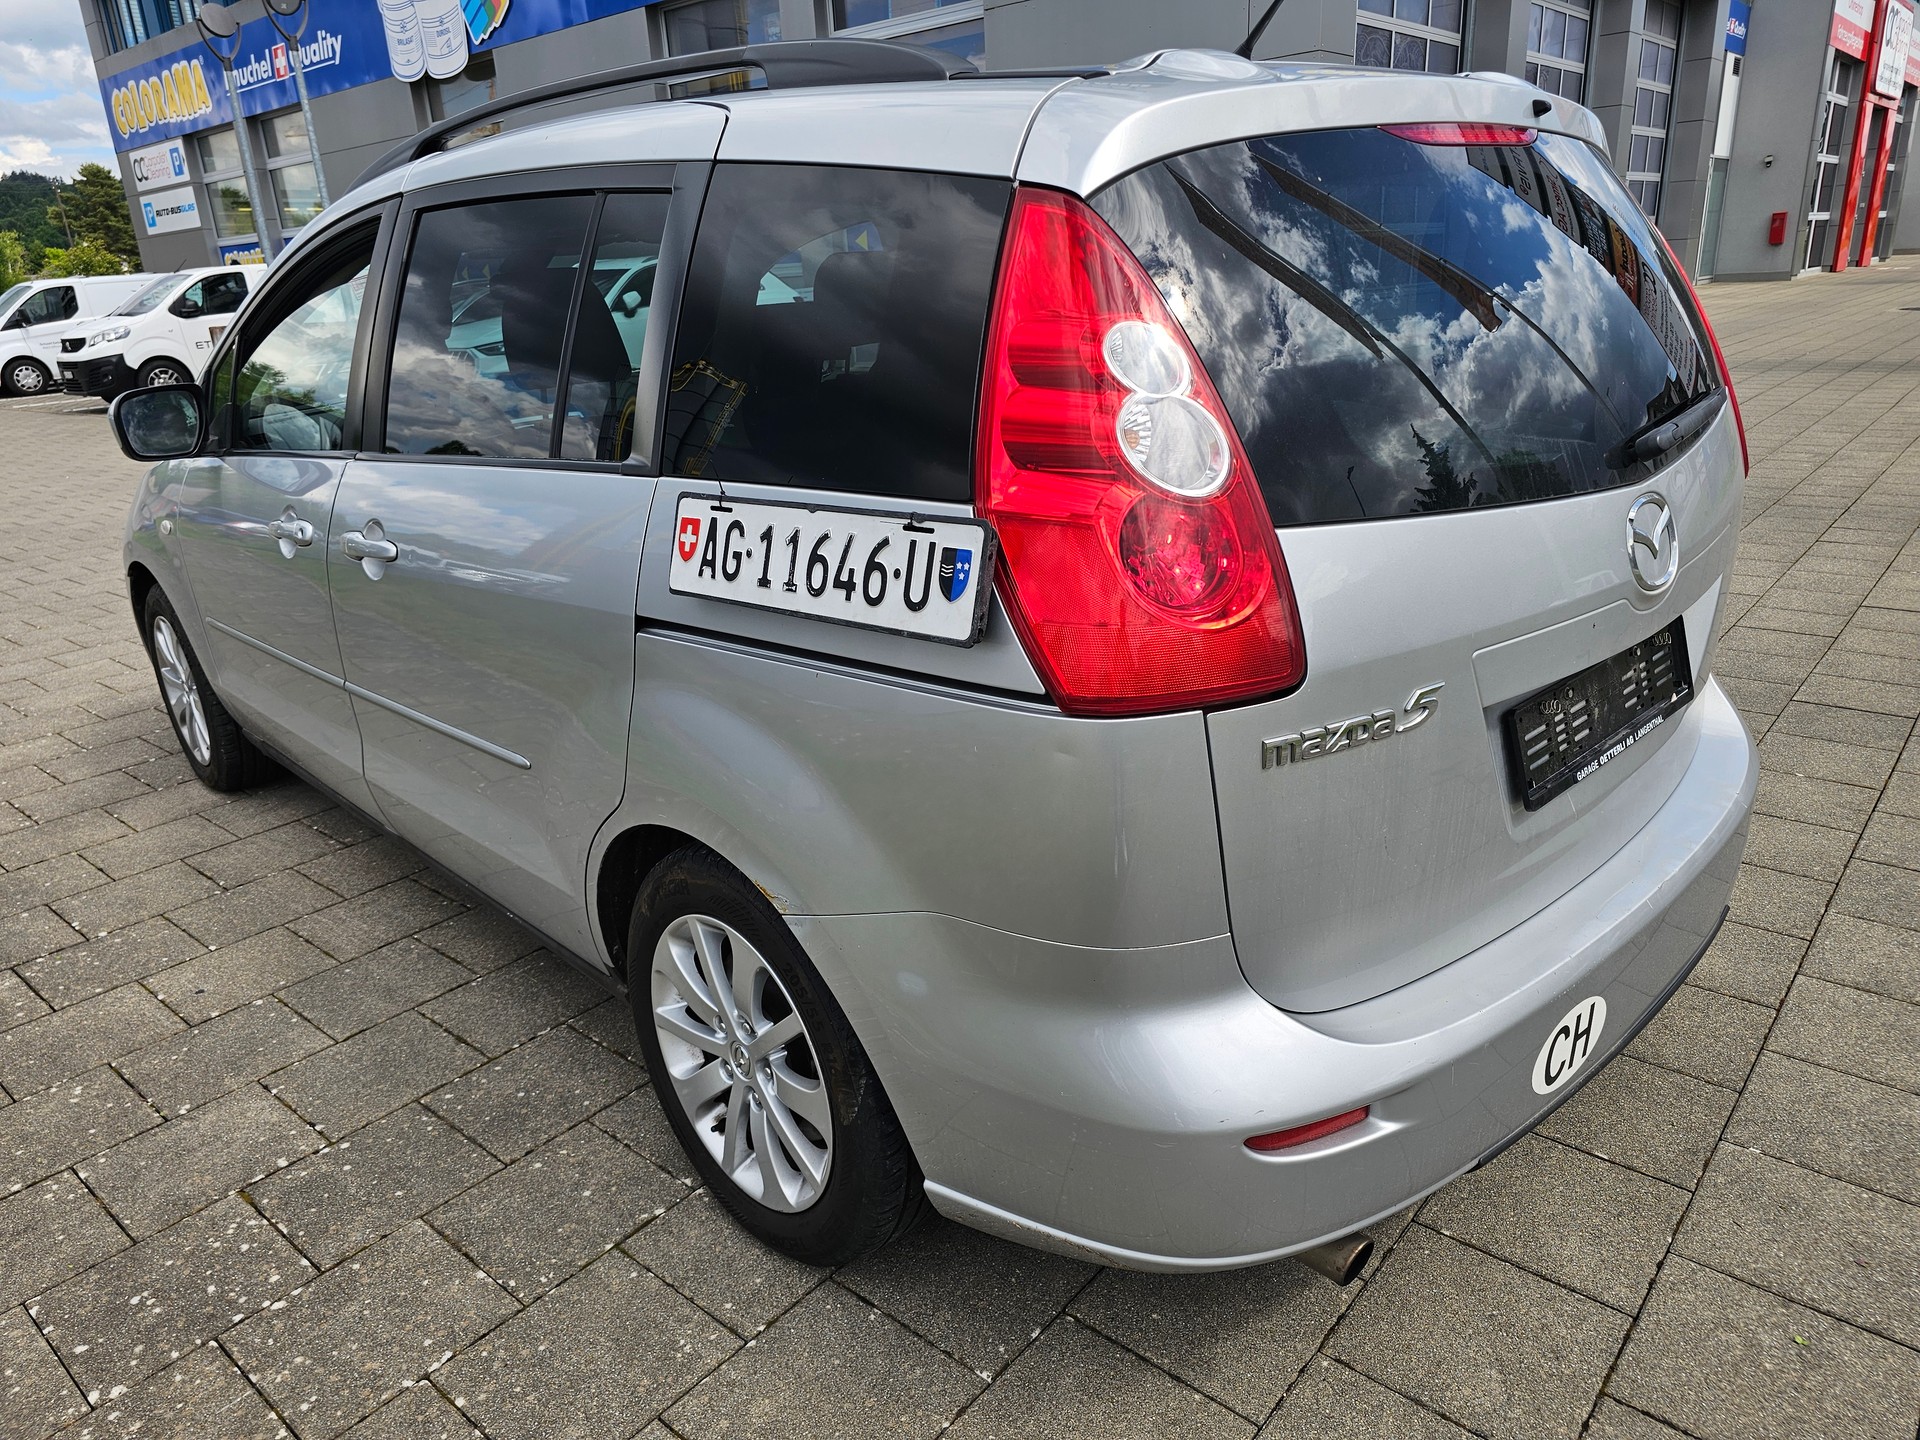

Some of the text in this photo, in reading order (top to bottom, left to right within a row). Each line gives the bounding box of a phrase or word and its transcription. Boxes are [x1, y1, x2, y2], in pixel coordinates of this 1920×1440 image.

[112, 60, 213, 138] COLORAMA
[1576, 714, 1665, 781] GARAGE OETTERLI AG LANGENTHAL
[1544, 1001, 1596, 1087] CH
